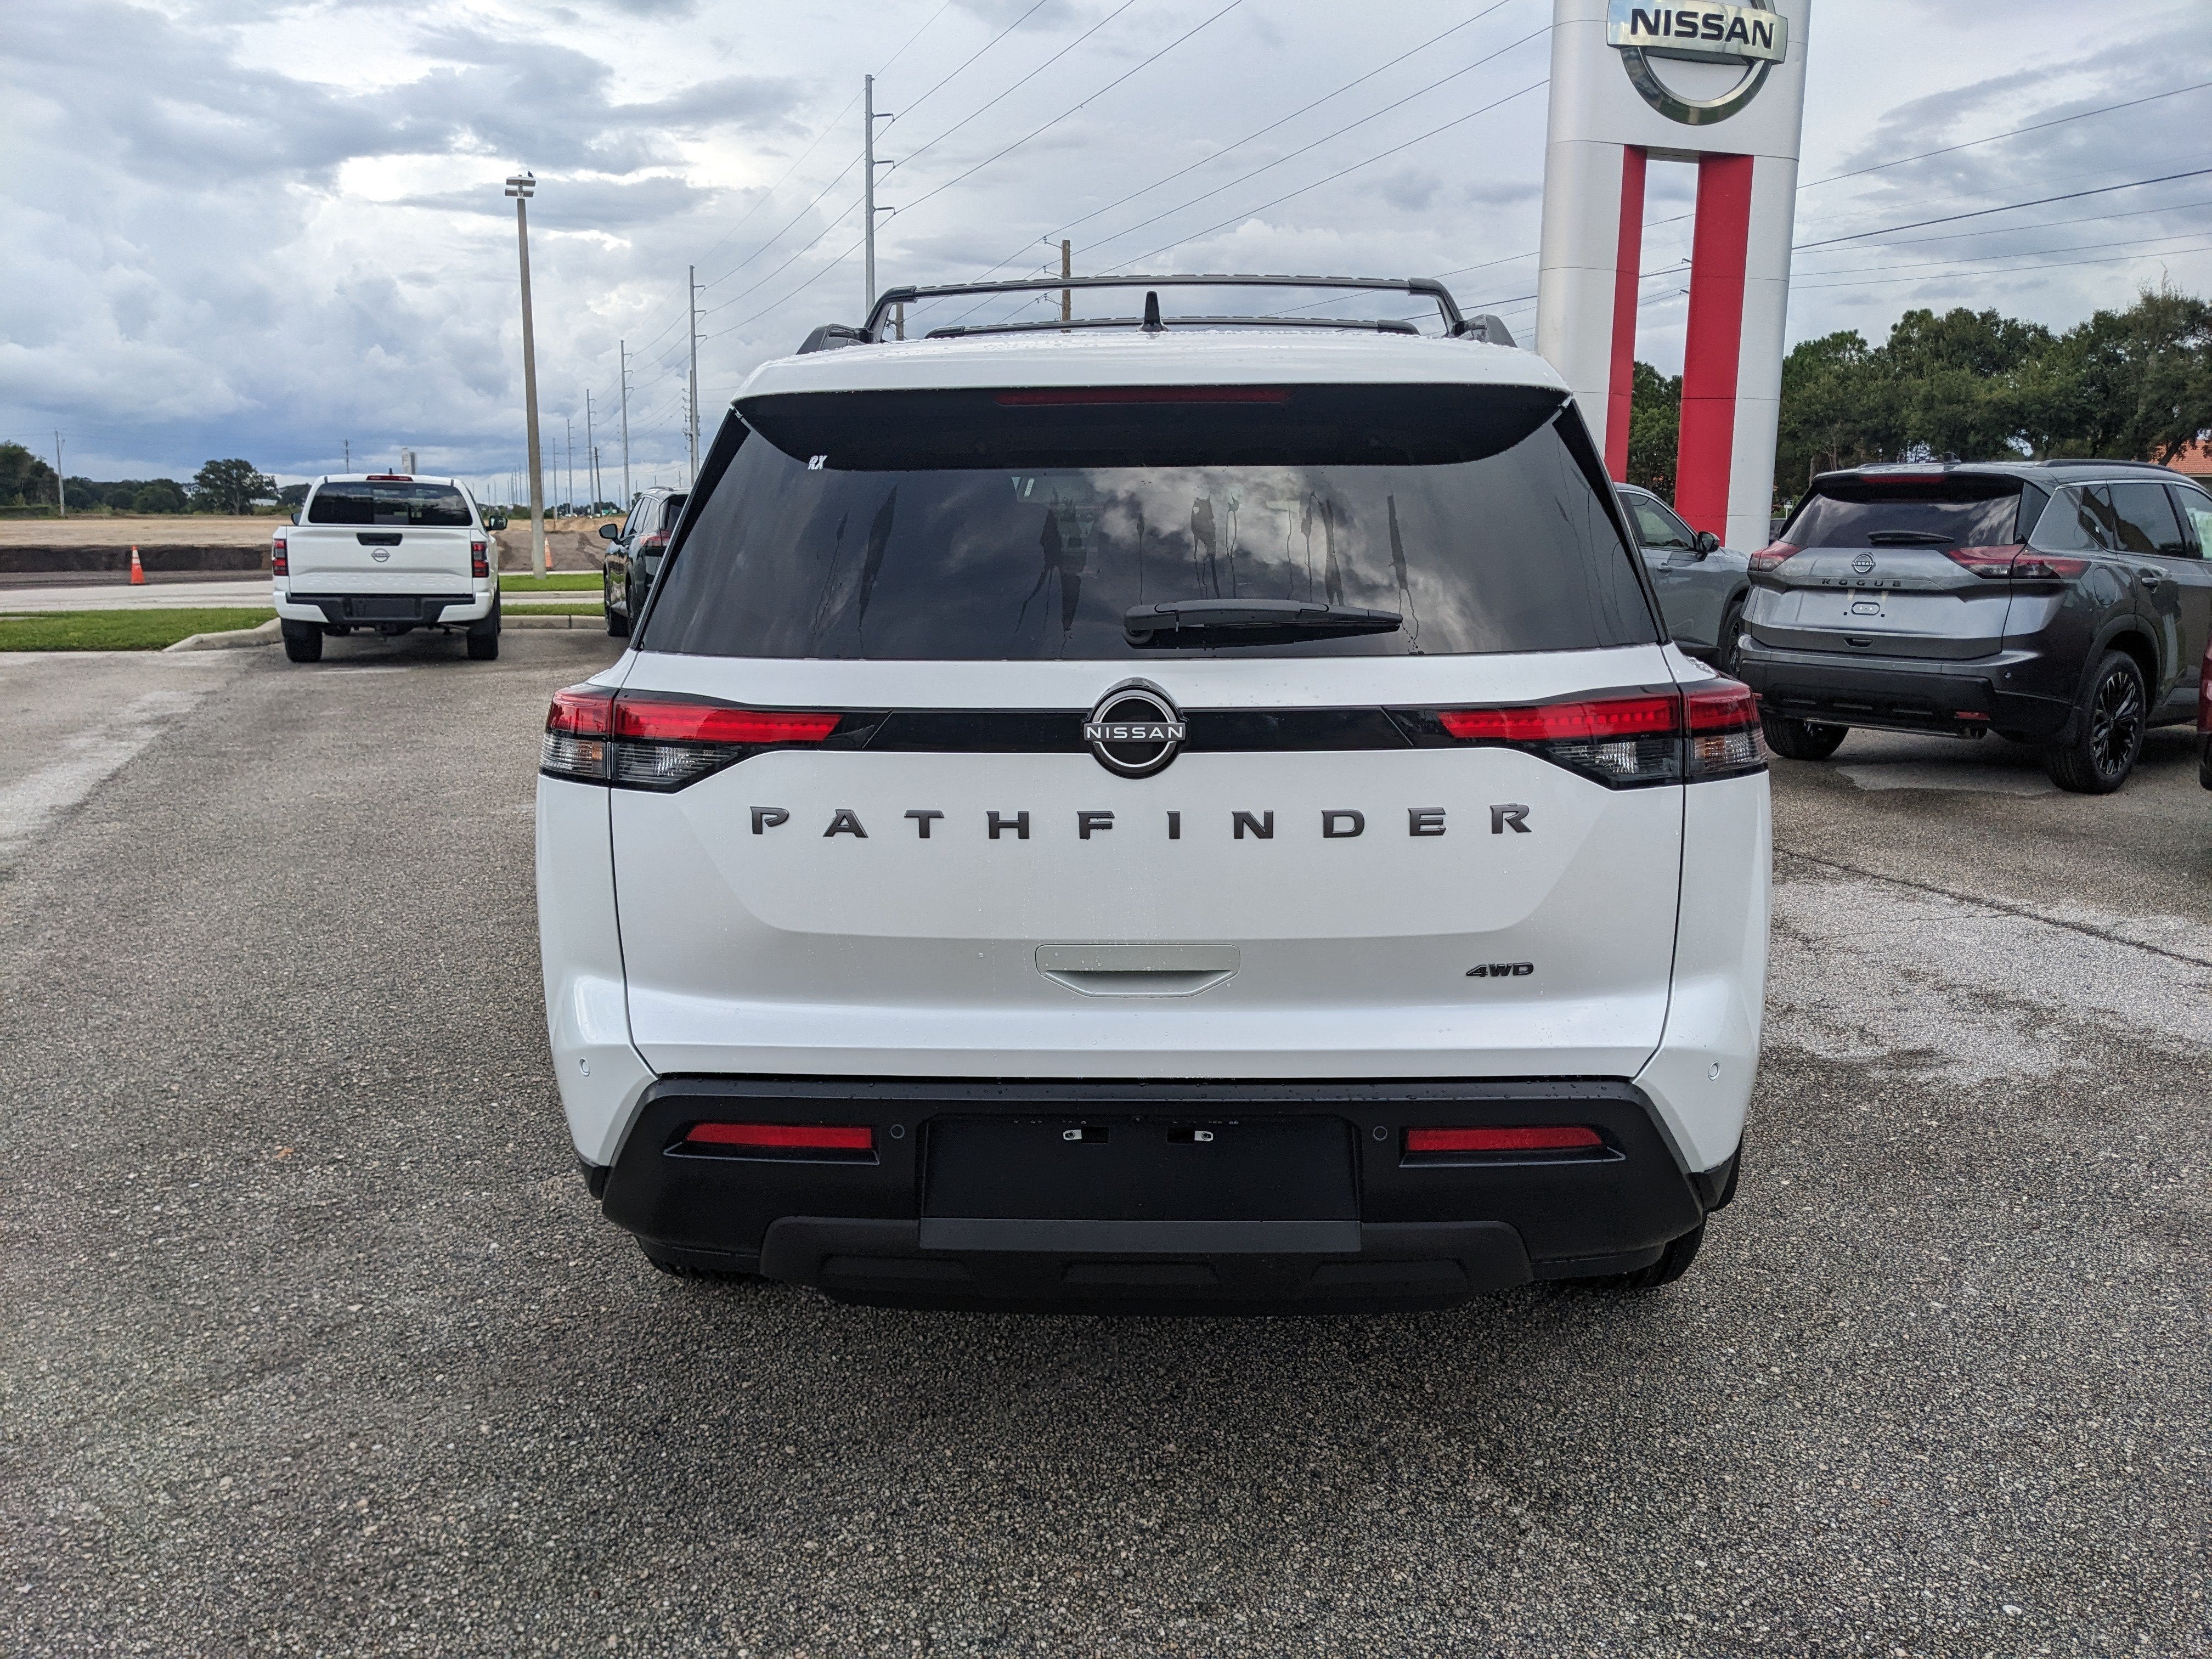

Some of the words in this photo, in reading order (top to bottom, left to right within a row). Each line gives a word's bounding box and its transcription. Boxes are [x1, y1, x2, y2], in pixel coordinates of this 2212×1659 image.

[1630, 8, 1774, 50] NISSAN
[1821, 579, 1901, 587] ROGUE
[1087, 726, 1182, 738] NISSAN
[749, 803, 1533, 840] PATHFINDER
[1465, 962, 1534, 978] 4WD
